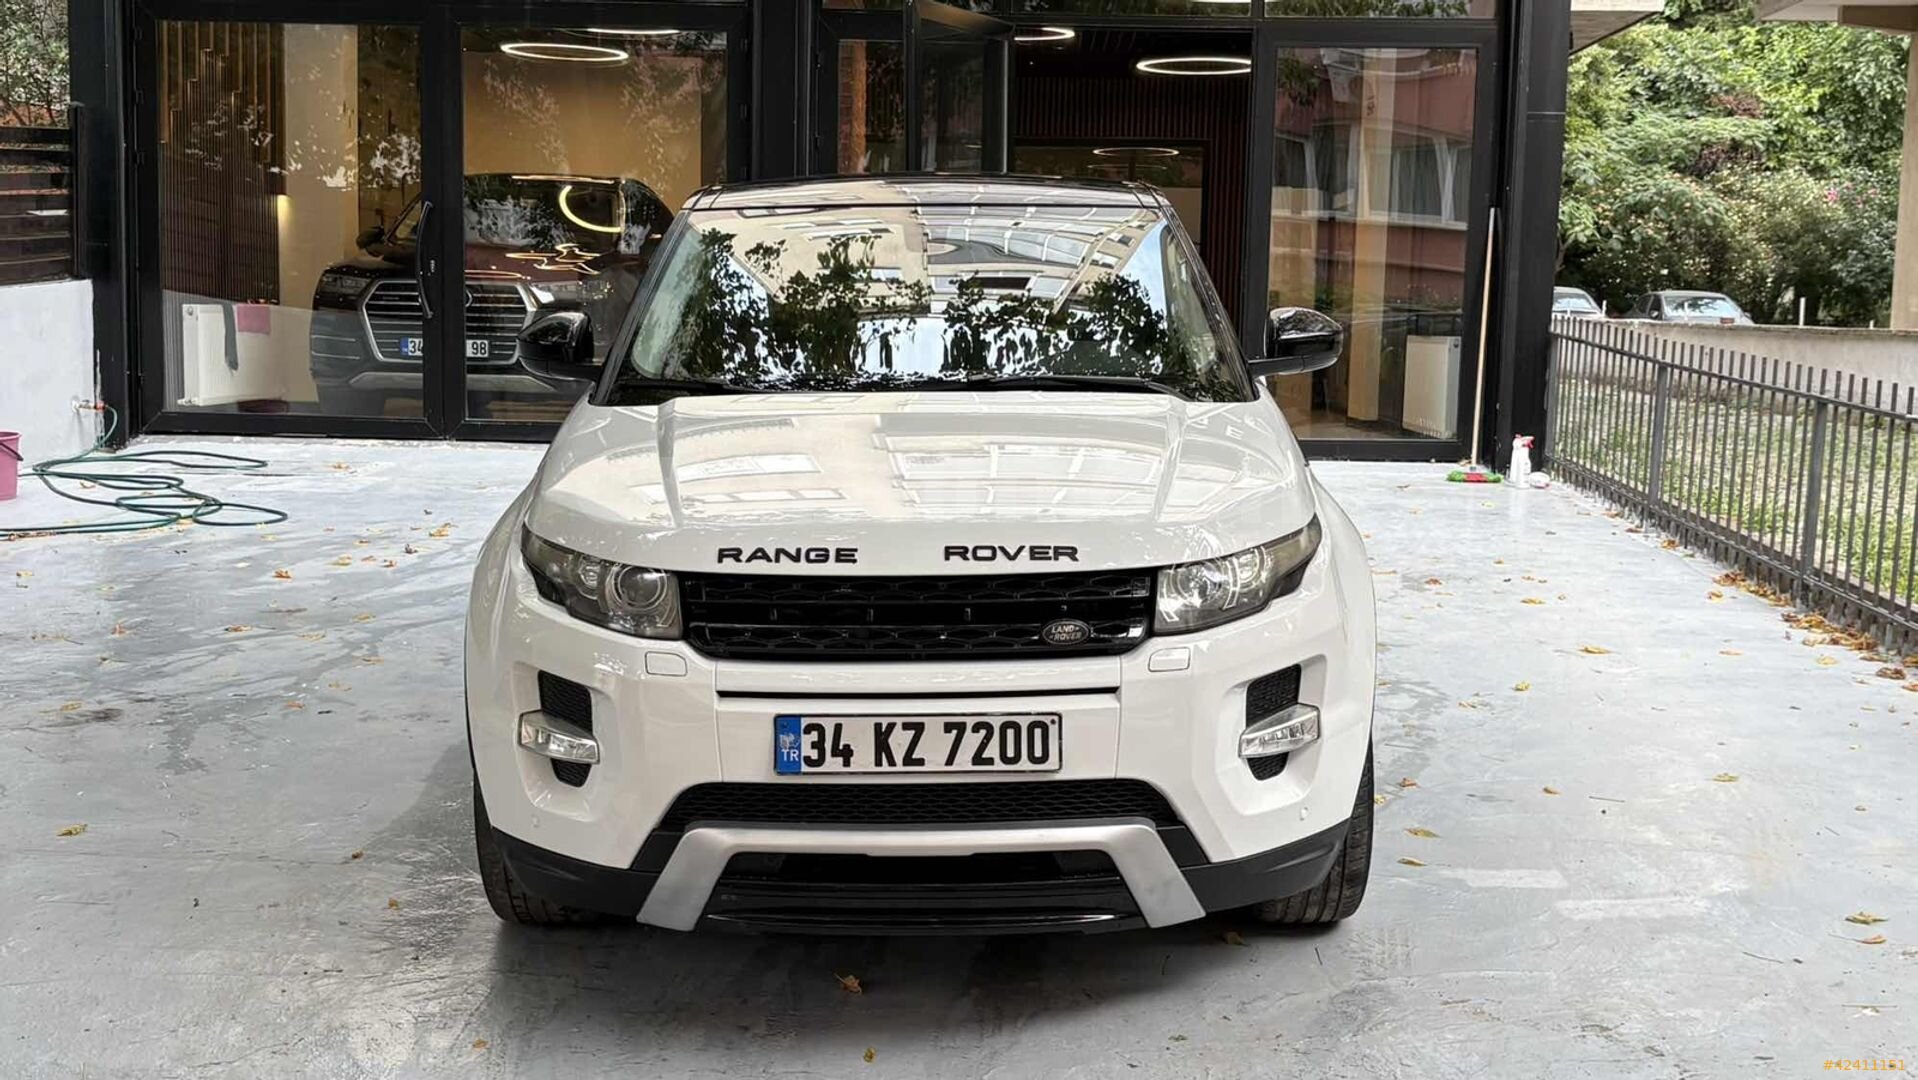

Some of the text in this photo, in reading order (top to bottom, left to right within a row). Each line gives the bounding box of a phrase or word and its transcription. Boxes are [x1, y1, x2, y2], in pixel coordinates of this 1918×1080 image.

[471, 341, 487, 356] 98
[717, 545, 1079, 564] RANGE ROVER
[803, 720, 1049, 768] 34 KZ 7200
[781, 749, 799, 761] TR
